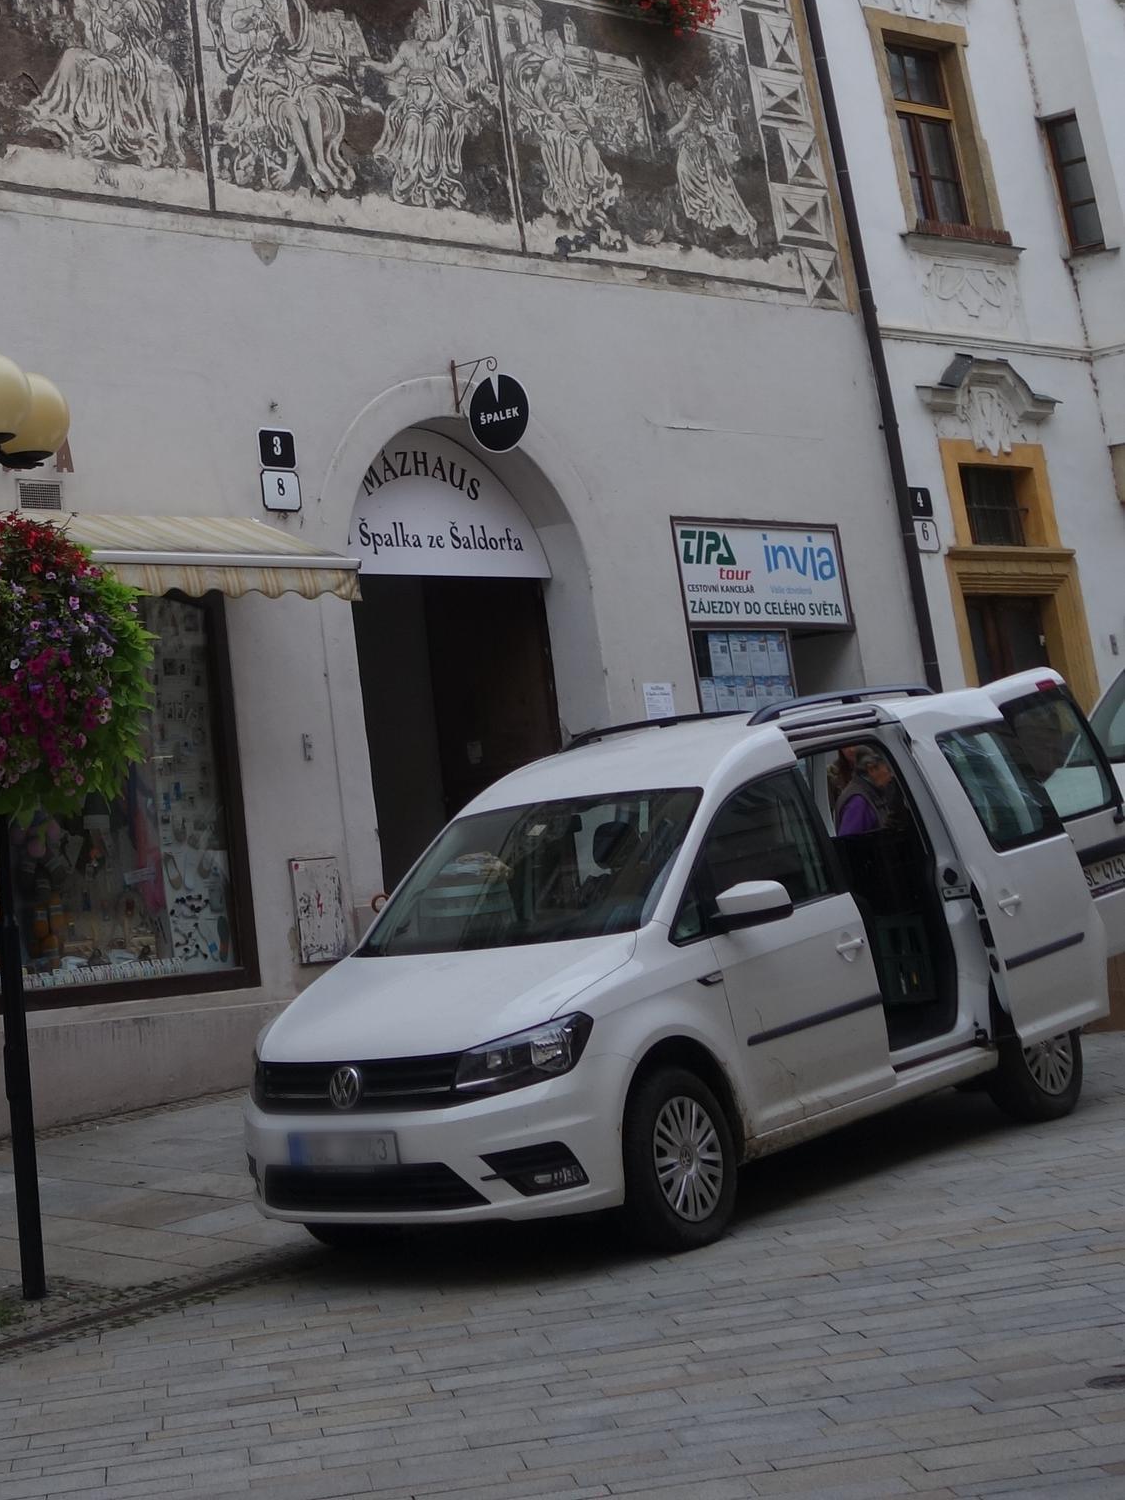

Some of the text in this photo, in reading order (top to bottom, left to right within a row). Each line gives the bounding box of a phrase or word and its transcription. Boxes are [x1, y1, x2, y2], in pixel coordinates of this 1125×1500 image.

[480, 406, 520, 425] ŠPALEK
[272, 435, 282, 456] 3
[362, 446, 481, 501] MÁZHAUS
[277, 477, 285, 496] 8
[916, 491, 924, 507] 4
[358, 517, 423, 555] Špalka
[426, 533, 445, 549] ze
[449, 520, 524, 551] Šaldorfa
[921, 522, 930, 541] 6
[680, 529, 737, 566] TIPA
[762, 533, 836, 581] invia
[719, 566, 751, 581] tour
[687, 583, 755, 594] CESTOVNÍ KANCELÁŘ
[690, 598, 843, 616] ZÁJEZDY DO CELÉHO SVĚTA
